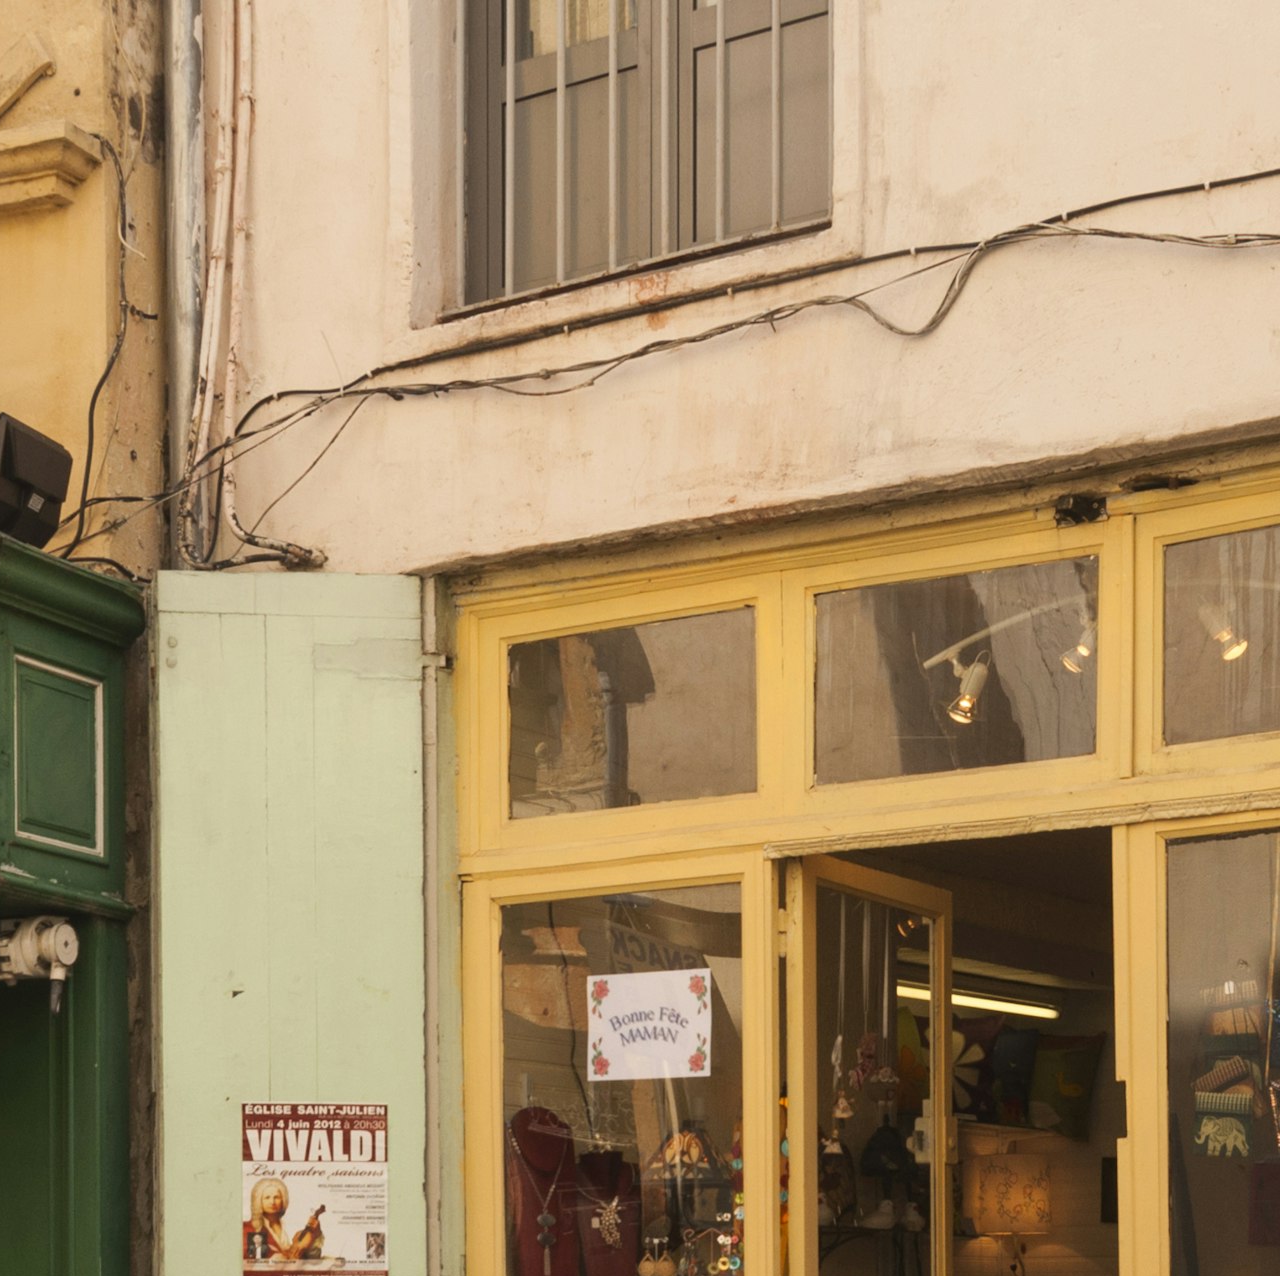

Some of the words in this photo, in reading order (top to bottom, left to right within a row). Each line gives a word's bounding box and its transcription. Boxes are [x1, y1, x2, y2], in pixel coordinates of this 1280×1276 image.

[609, 1009, 655, 1031] Bonne
[659, 1006, 689, 1029] Fête
[620, 1025, 680, 1047] MAMAN
[245, 1103, 292, 1115] ÉGLISE
[297, 1104, 385, 1116] SAINT-JULIEN
[245, 1120, 274, 1129] Lundi
[276, 1120, 285, 1129] 4
[288, 1120, 310, 1131] juin
[314, 1120, 342, 1129] 2012
[343, 1119, 351, 1129] à
[353, 1120, 385, 1130] 20h30
[245, 1129, 386, 1162] VIVALDI
[246, 1163, 276, 1177] Les
[279, 1165, 327, 1180] quatre
[327, 1166, 384, 1180] saisons
